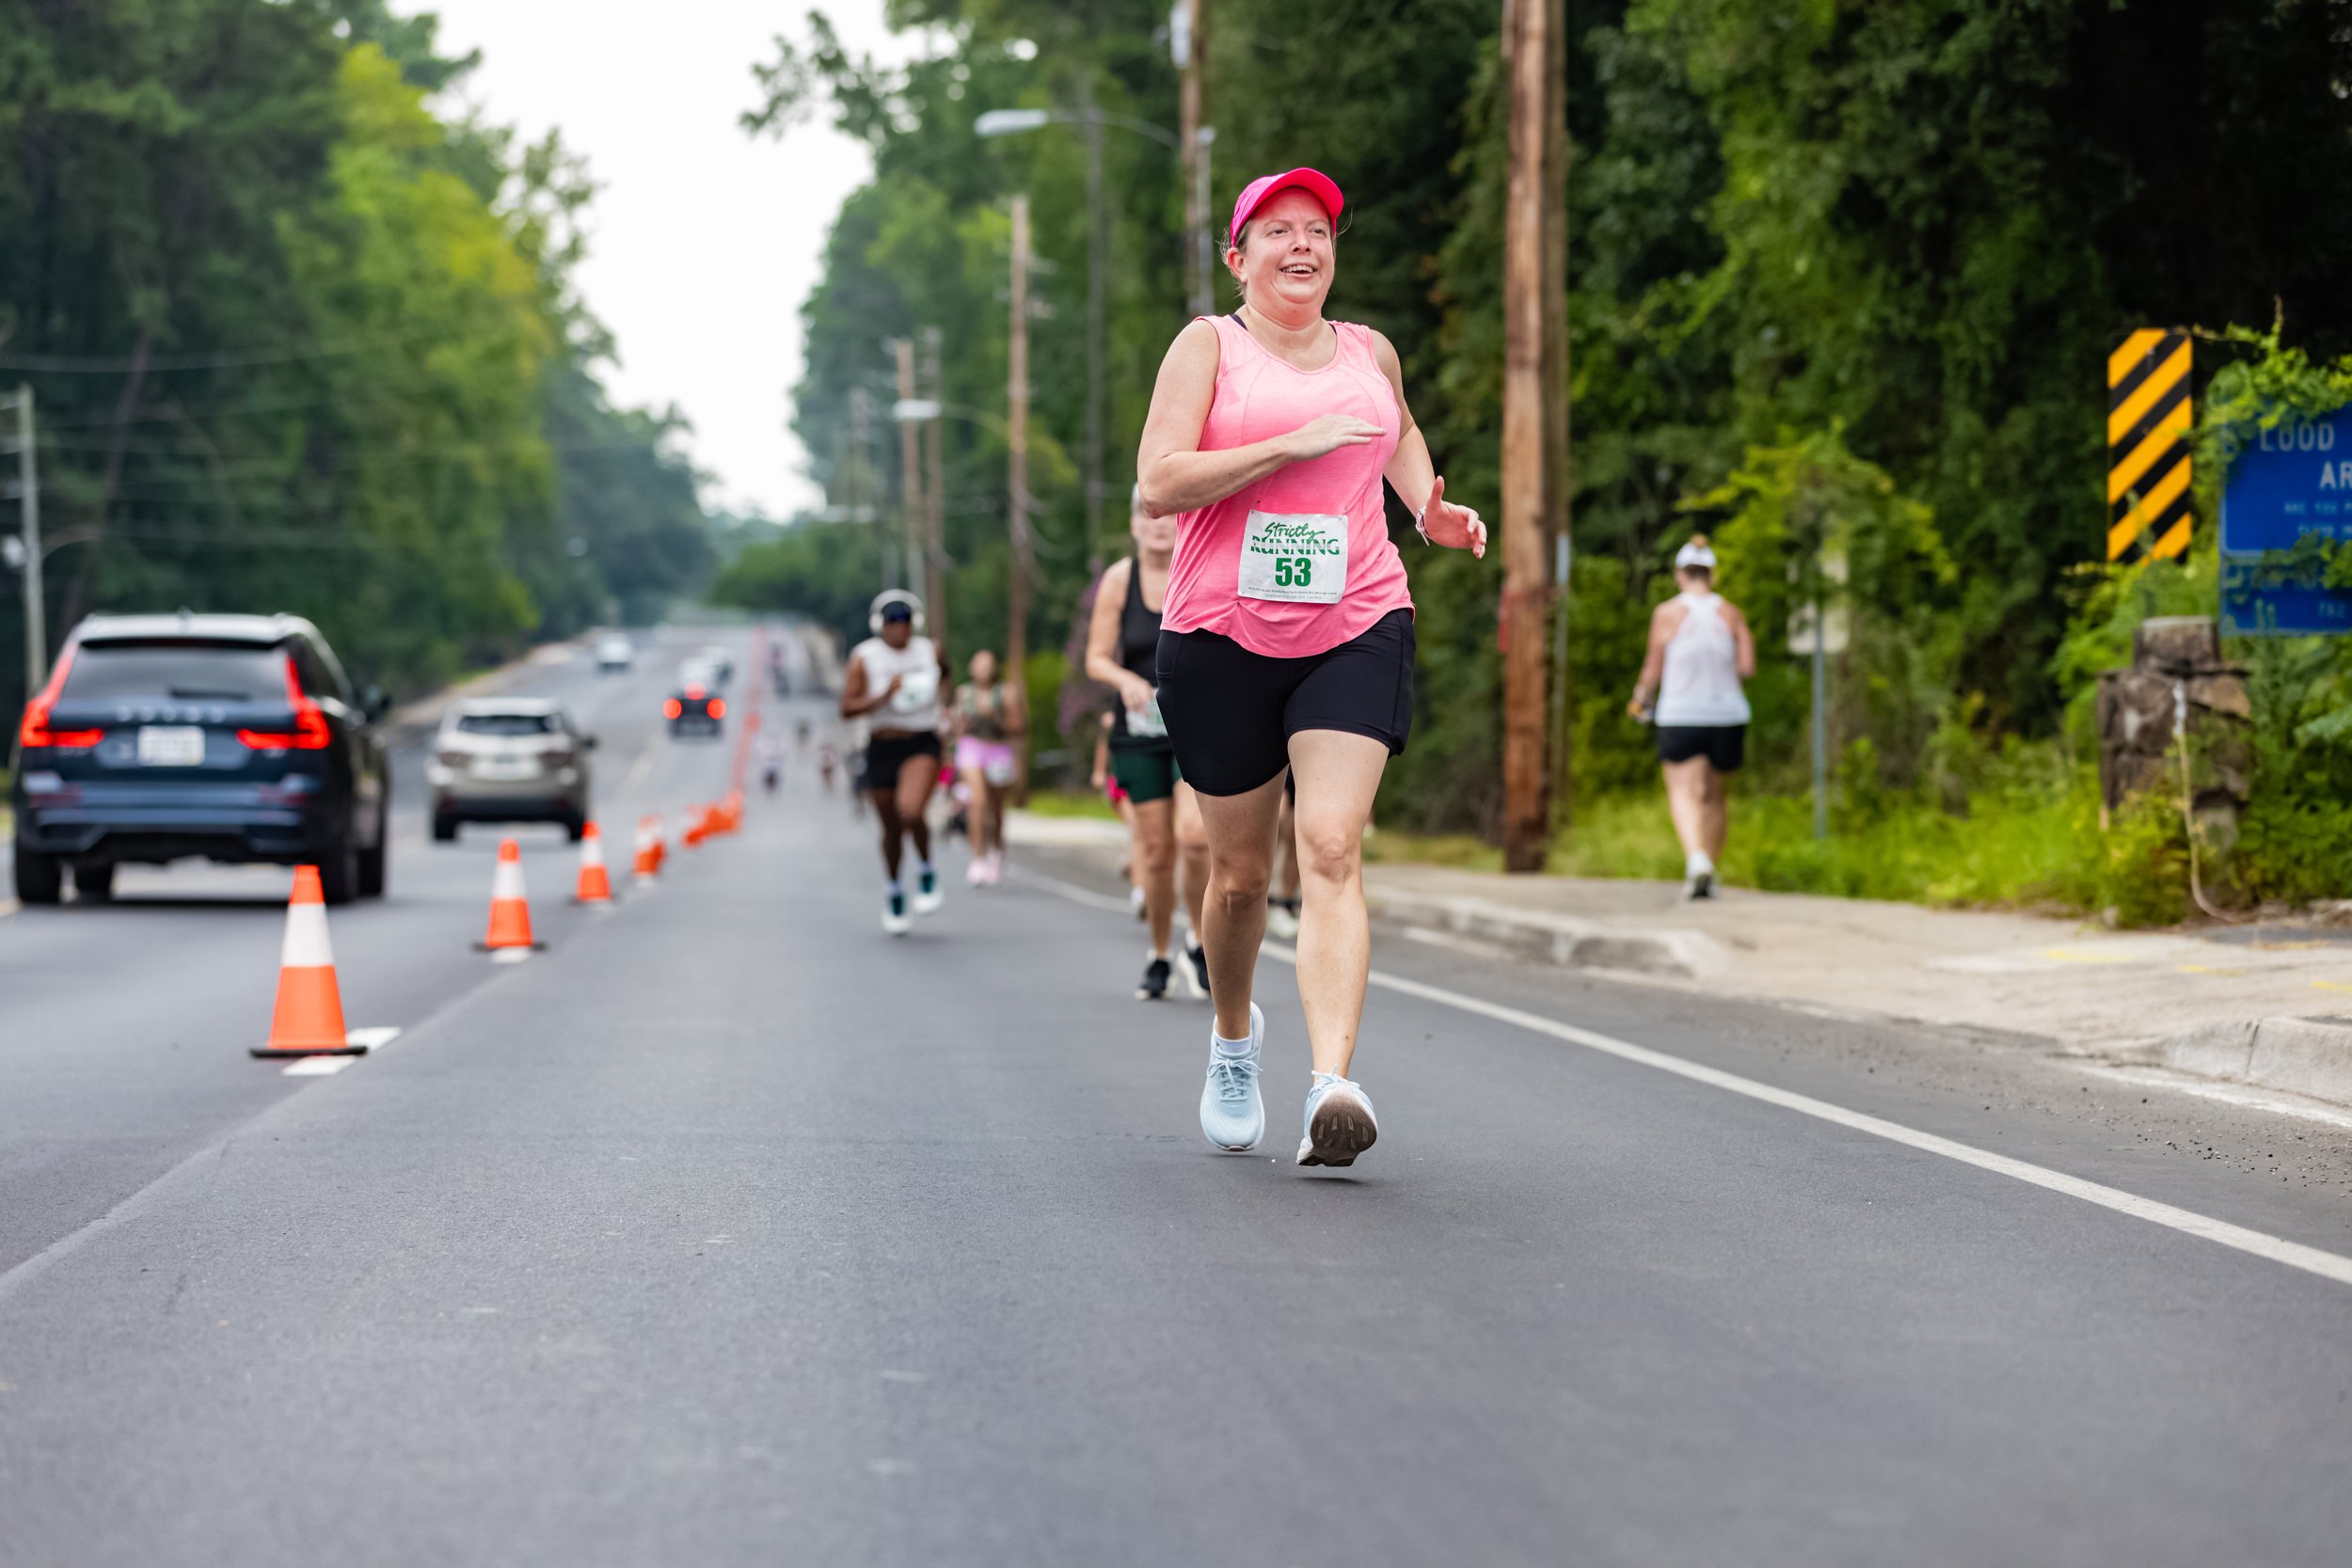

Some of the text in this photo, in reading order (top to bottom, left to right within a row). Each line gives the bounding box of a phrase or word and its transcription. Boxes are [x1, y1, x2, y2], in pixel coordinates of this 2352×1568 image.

[2260, 422, 2335, 451] LOOD
[1250, 535, 1340, 556] RUNNING
[1263, 522, 1326, 544] Strictly
[1275, 557, 1312, 588] 53
